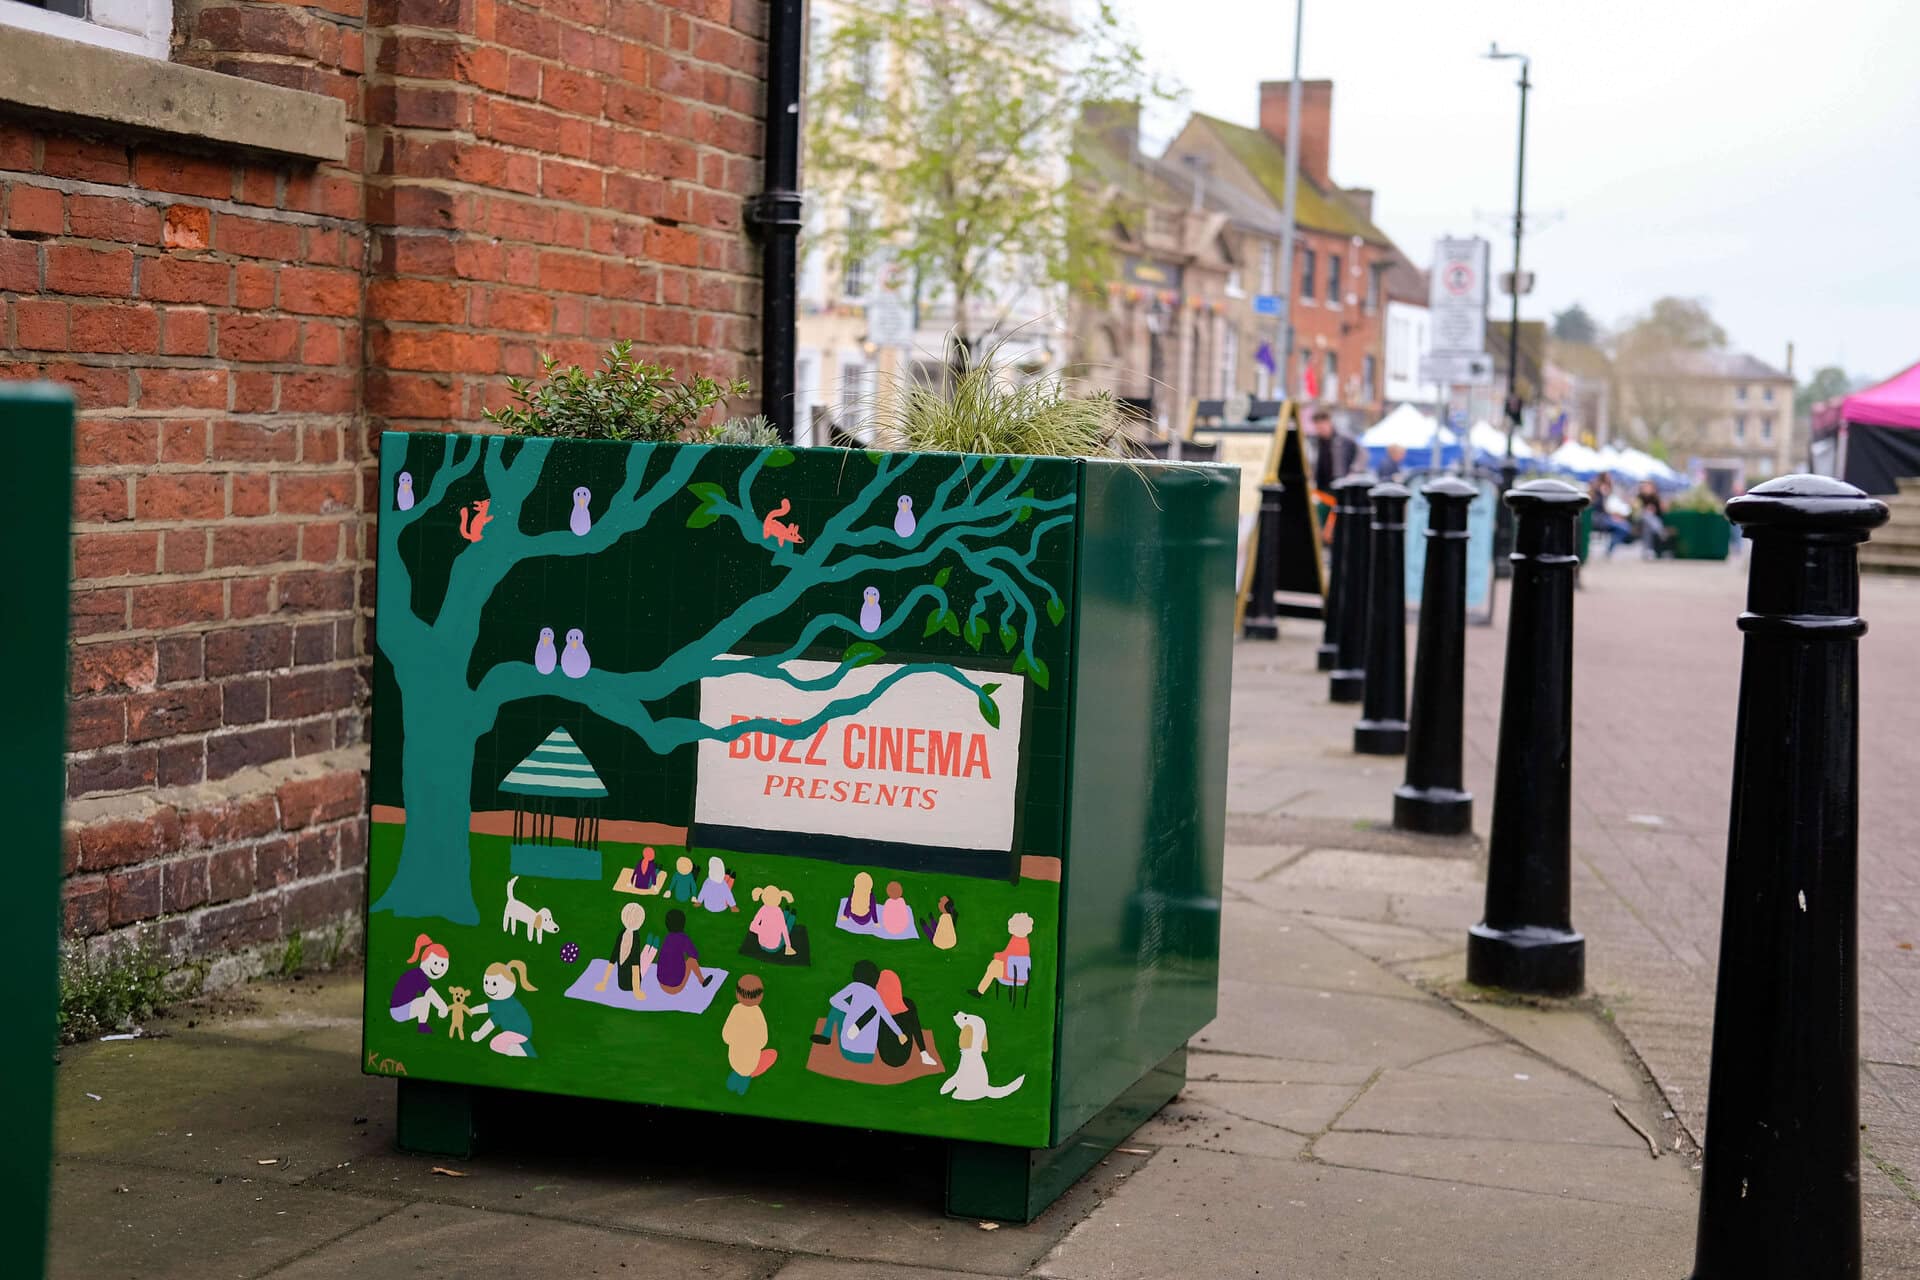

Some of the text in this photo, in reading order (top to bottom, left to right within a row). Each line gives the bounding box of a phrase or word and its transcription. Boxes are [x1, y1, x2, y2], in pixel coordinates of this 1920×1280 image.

[729, 714, 992, 779] BUZZ CINEMA
[763, 775, 939, 810] PRESENTS
[368, 1049, 408, 1076] KATA
